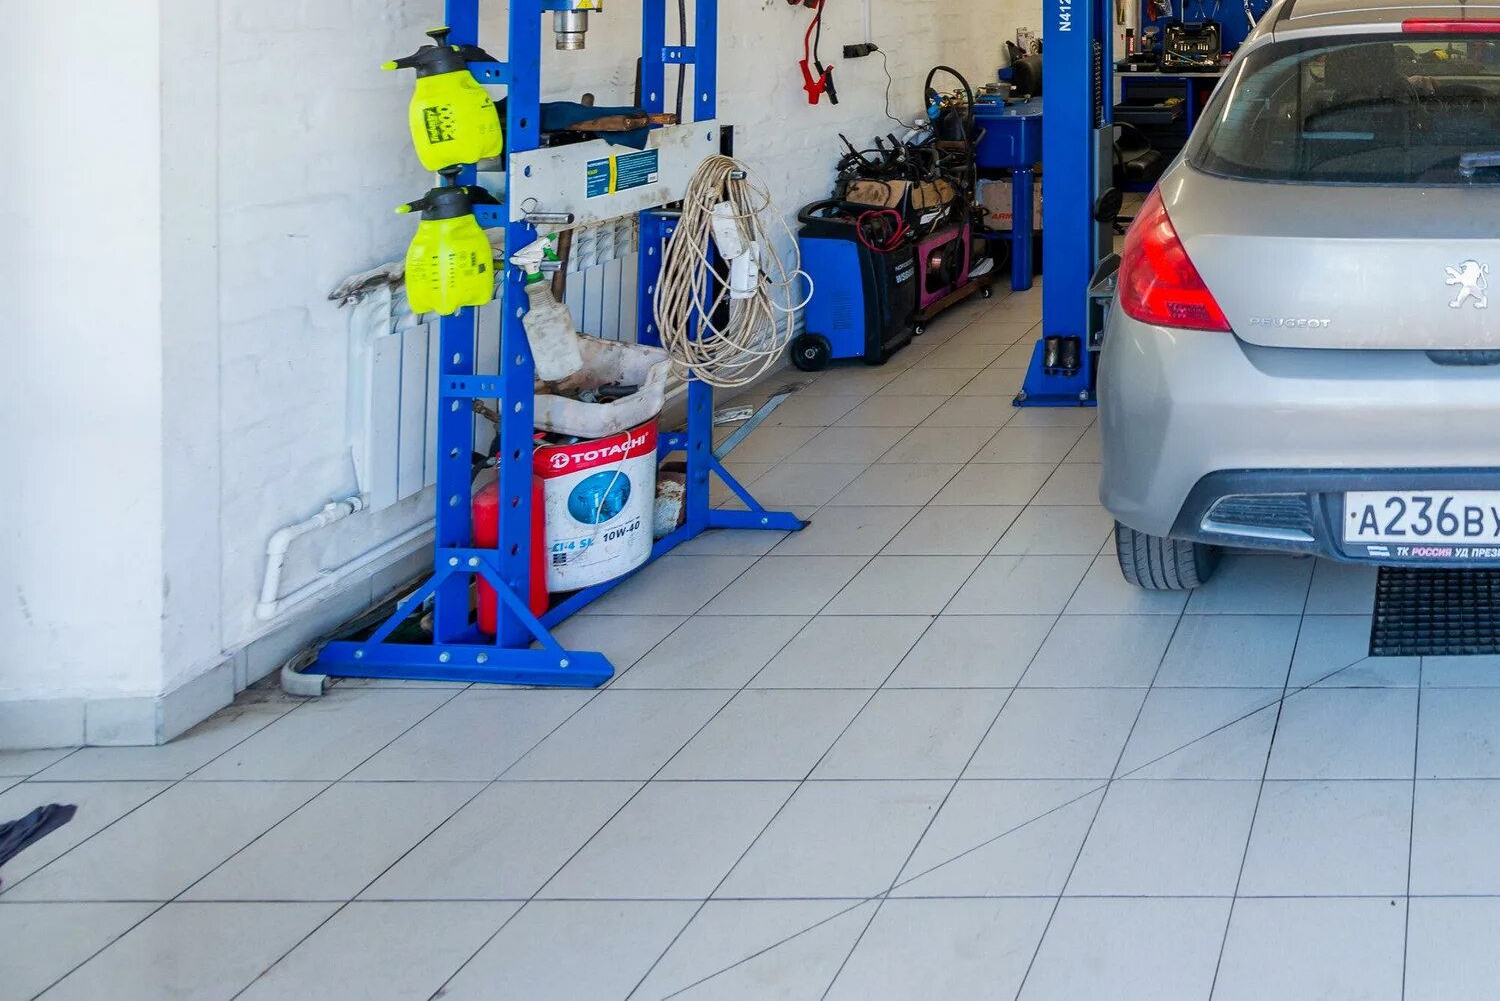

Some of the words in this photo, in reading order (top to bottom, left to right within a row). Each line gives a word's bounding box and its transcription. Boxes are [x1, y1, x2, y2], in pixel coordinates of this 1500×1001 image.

[1248, 316, 1332, 329] PEUGEOT
[571, 435, 646, 464] TOTACHI
[602, 520, 641, 543] 10W-40
[1396, 547, 1410, 557] ТК
[1411, 547, 1452, 558] РОССИЯ
[1454, 548, 1469, 558] УД
